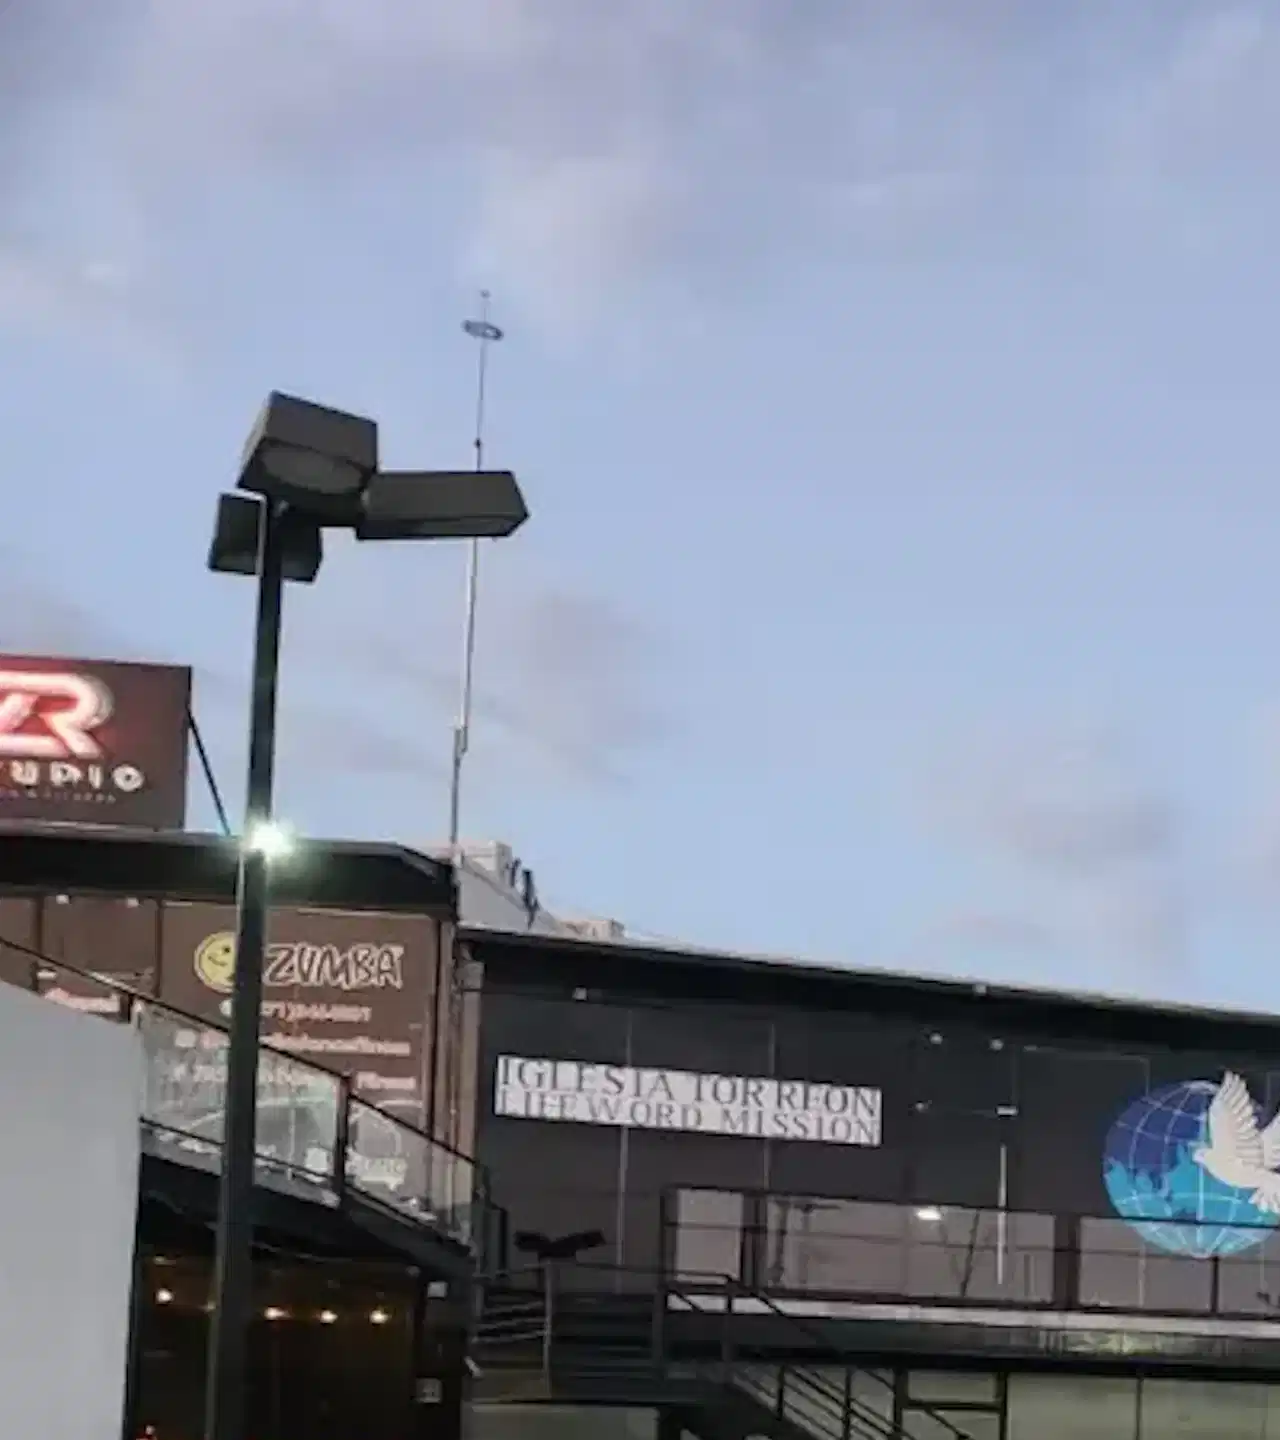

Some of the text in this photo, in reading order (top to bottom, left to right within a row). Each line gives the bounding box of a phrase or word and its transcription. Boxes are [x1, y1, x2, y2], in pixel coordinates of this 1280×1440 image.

[0, 759, 145, 793] UDIO
[262, 942, 405, 990] ZUMBA
[502, 1057, 879, 1118] IGLESIA TORREON
[721, 1107, 879, 1144] MISSION
